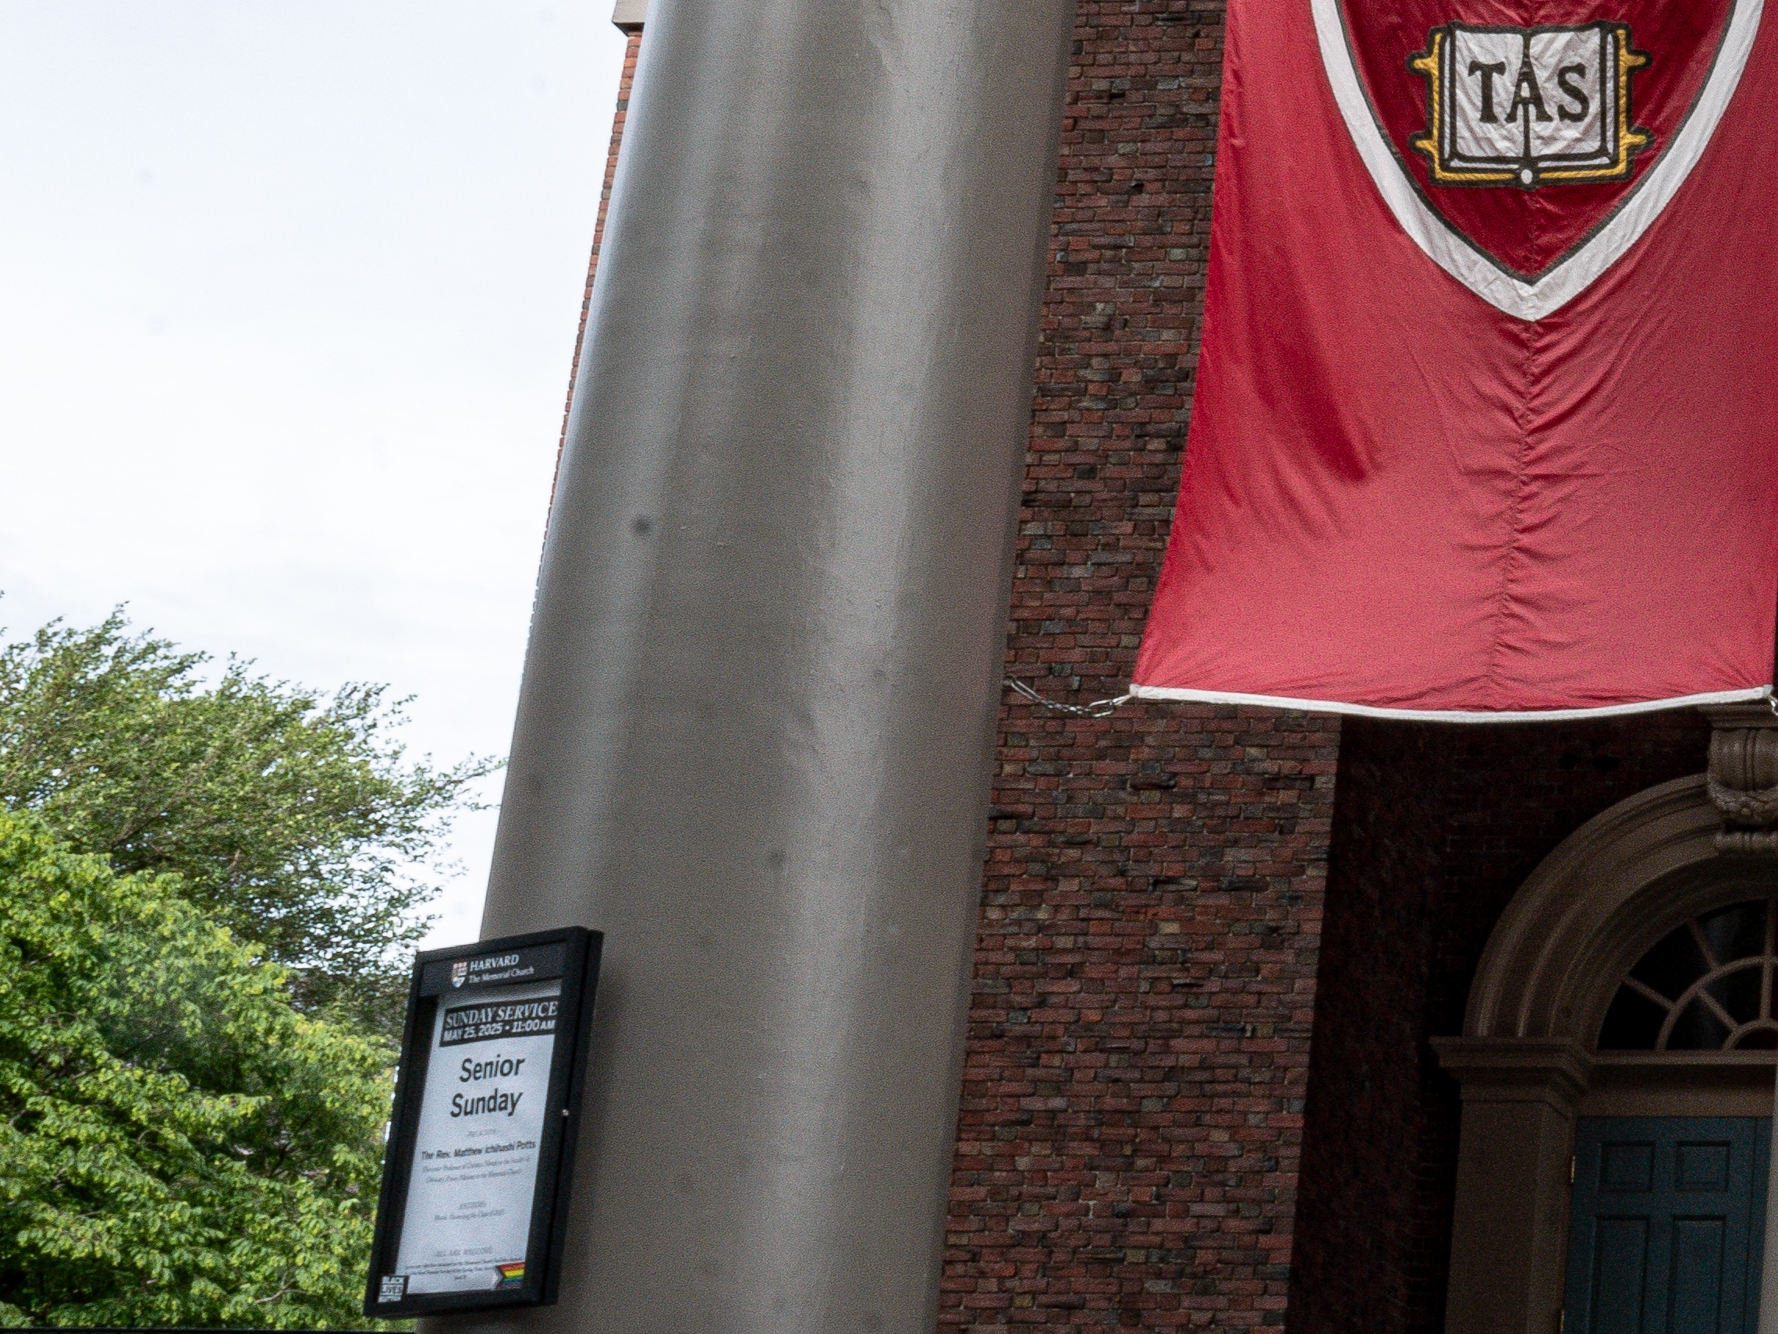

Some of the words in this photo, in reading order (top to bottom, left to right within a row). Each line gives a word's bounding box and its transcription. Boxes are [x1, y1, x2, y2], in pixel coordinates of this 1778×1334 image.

[1468, 52, 1591, 124] TAS
[468, 975, 480, 984] The
[510, 965, 535, 979] Church
[469, 954, 520, 972] HARVARD
[445, 1007, 496, 1028] SUNDAY
[495, 1000, 559, 1021] SERVICE
[443, 1028, 462, 1042] MAY
[463, 1025, 477, 1039] 25,
[478, 1022, 503, 1036] 2025
[459, 1054, 525, 1083] Senior
[450, 1087, 523, 1118] Sunday
[421, 1150, 434, 1160] The
[436, 1149, 451, 1159] Rev.
[454, 1147, 482, 1157] Matthew
[516, 1140, 536, 1150] Potts
